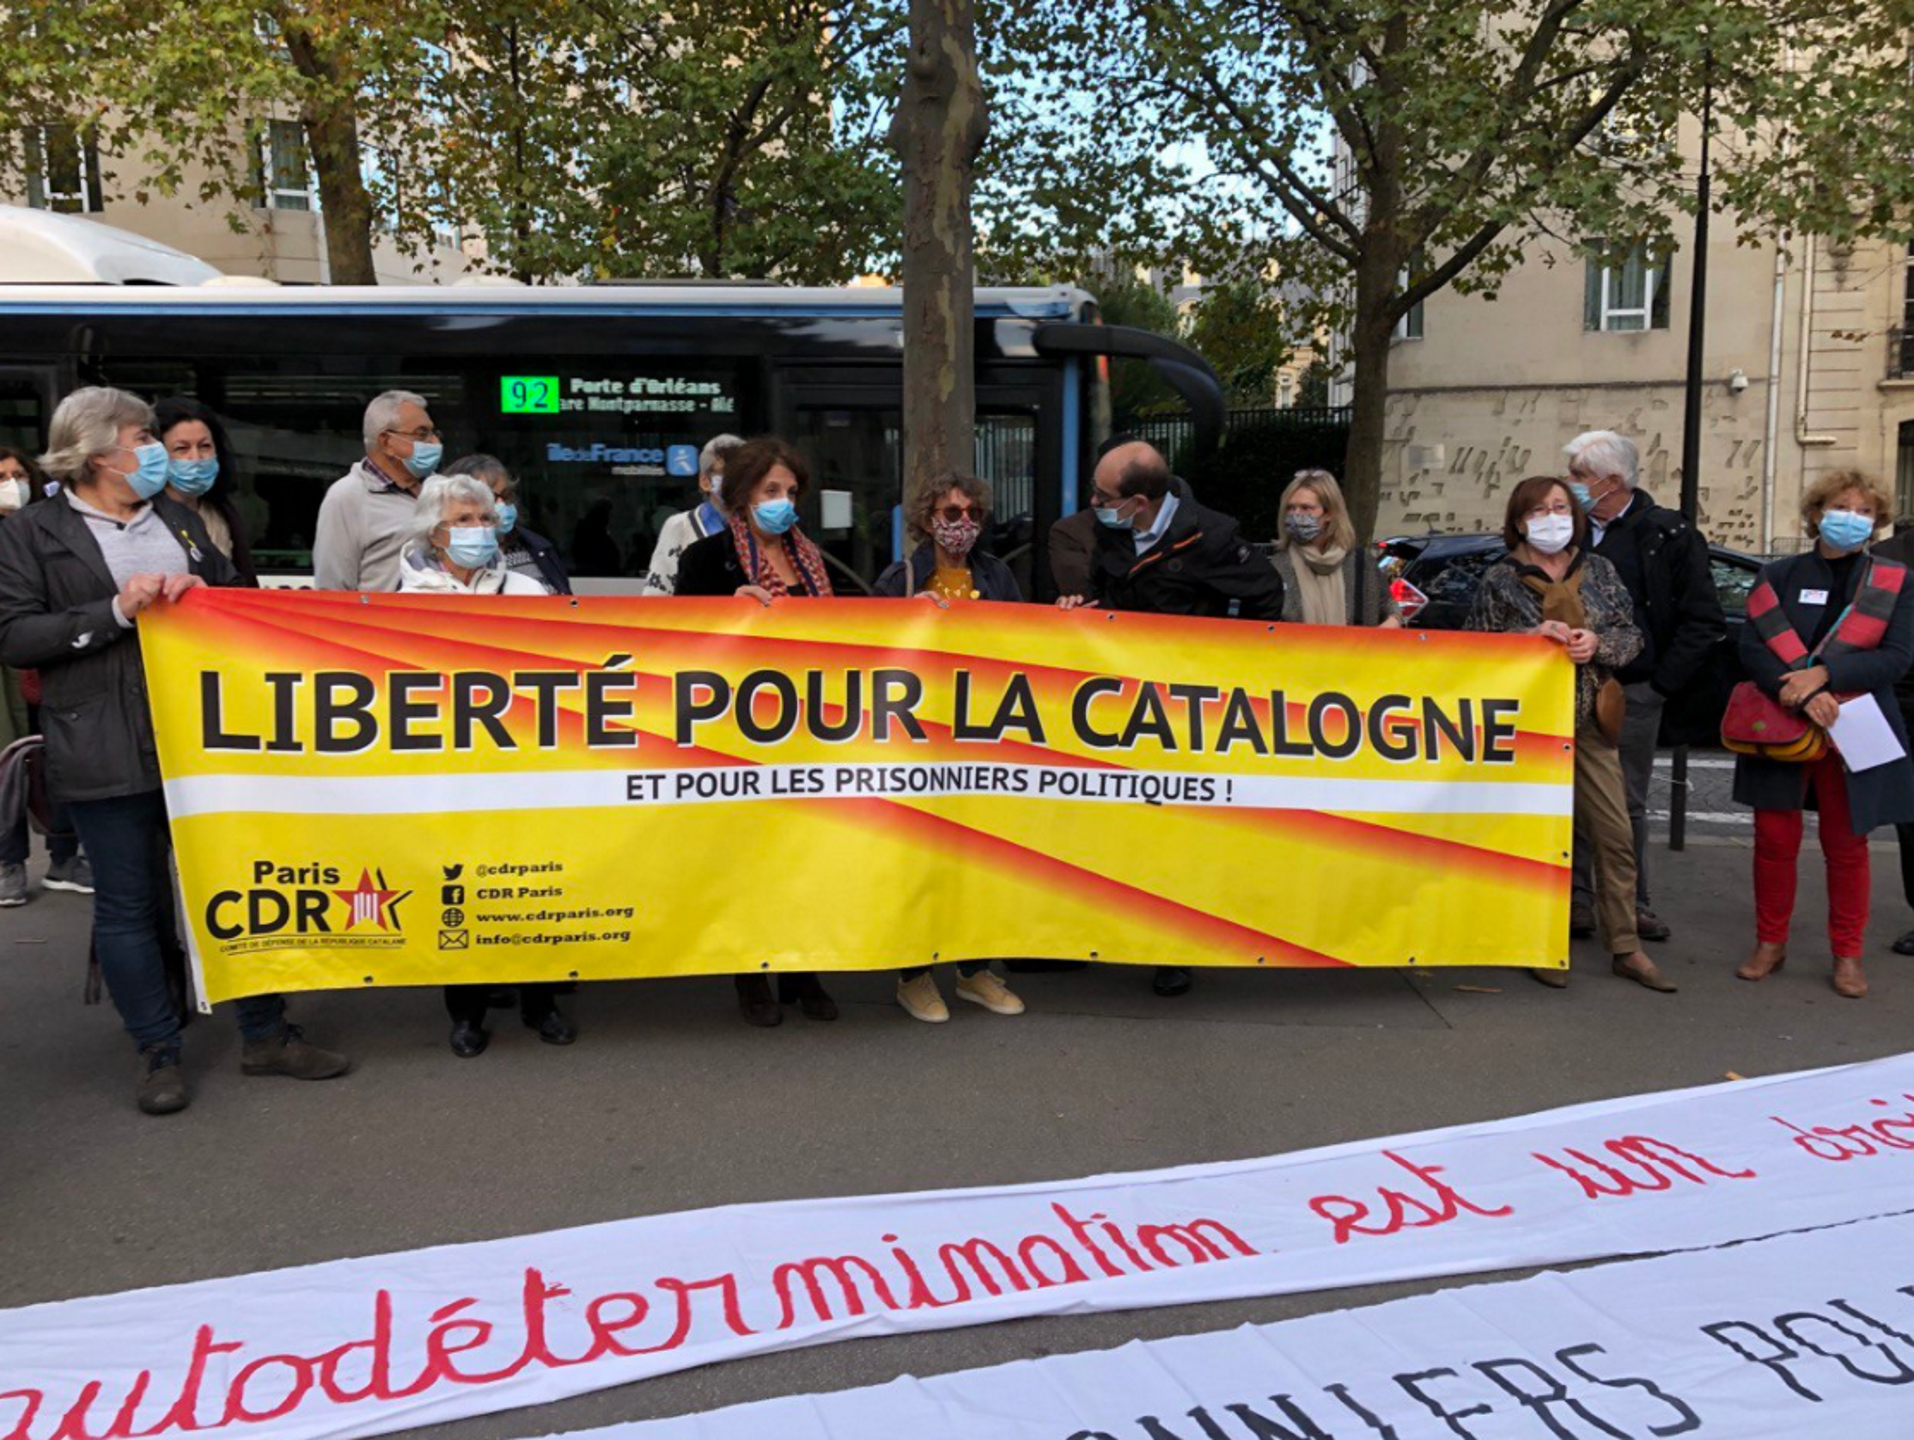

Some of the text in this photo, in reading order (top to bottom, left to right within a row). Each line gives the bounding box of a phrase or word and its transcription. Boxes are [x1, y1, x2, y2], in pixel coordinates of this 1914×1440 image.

[512, 381, 548, 409] 92
[570, 377, 721, 394] Porte d'Orléans
[587, 396, 696, 414] Montparnasse
[200, 653, 1520, 762] LIBERTÉ POUR LA CATALOGNE
[626, 766, 1233, 806] ET POUR LES PRISONNIERS POLITIQUES !
[253, 861, 341, 885] Paris
[476, 861, 564, 878] @cdrparis
[476, 886, 563, 900] CDR Paris
[205, 889, 332, 940] CDR
[476, 907, 634, 922] www.cdrparis.org
[475, 930, 631, 945] info@cdrparis.org
[1309, 1149, 1514, 1243] est
[1532, 1135, 1756, 1198] un
